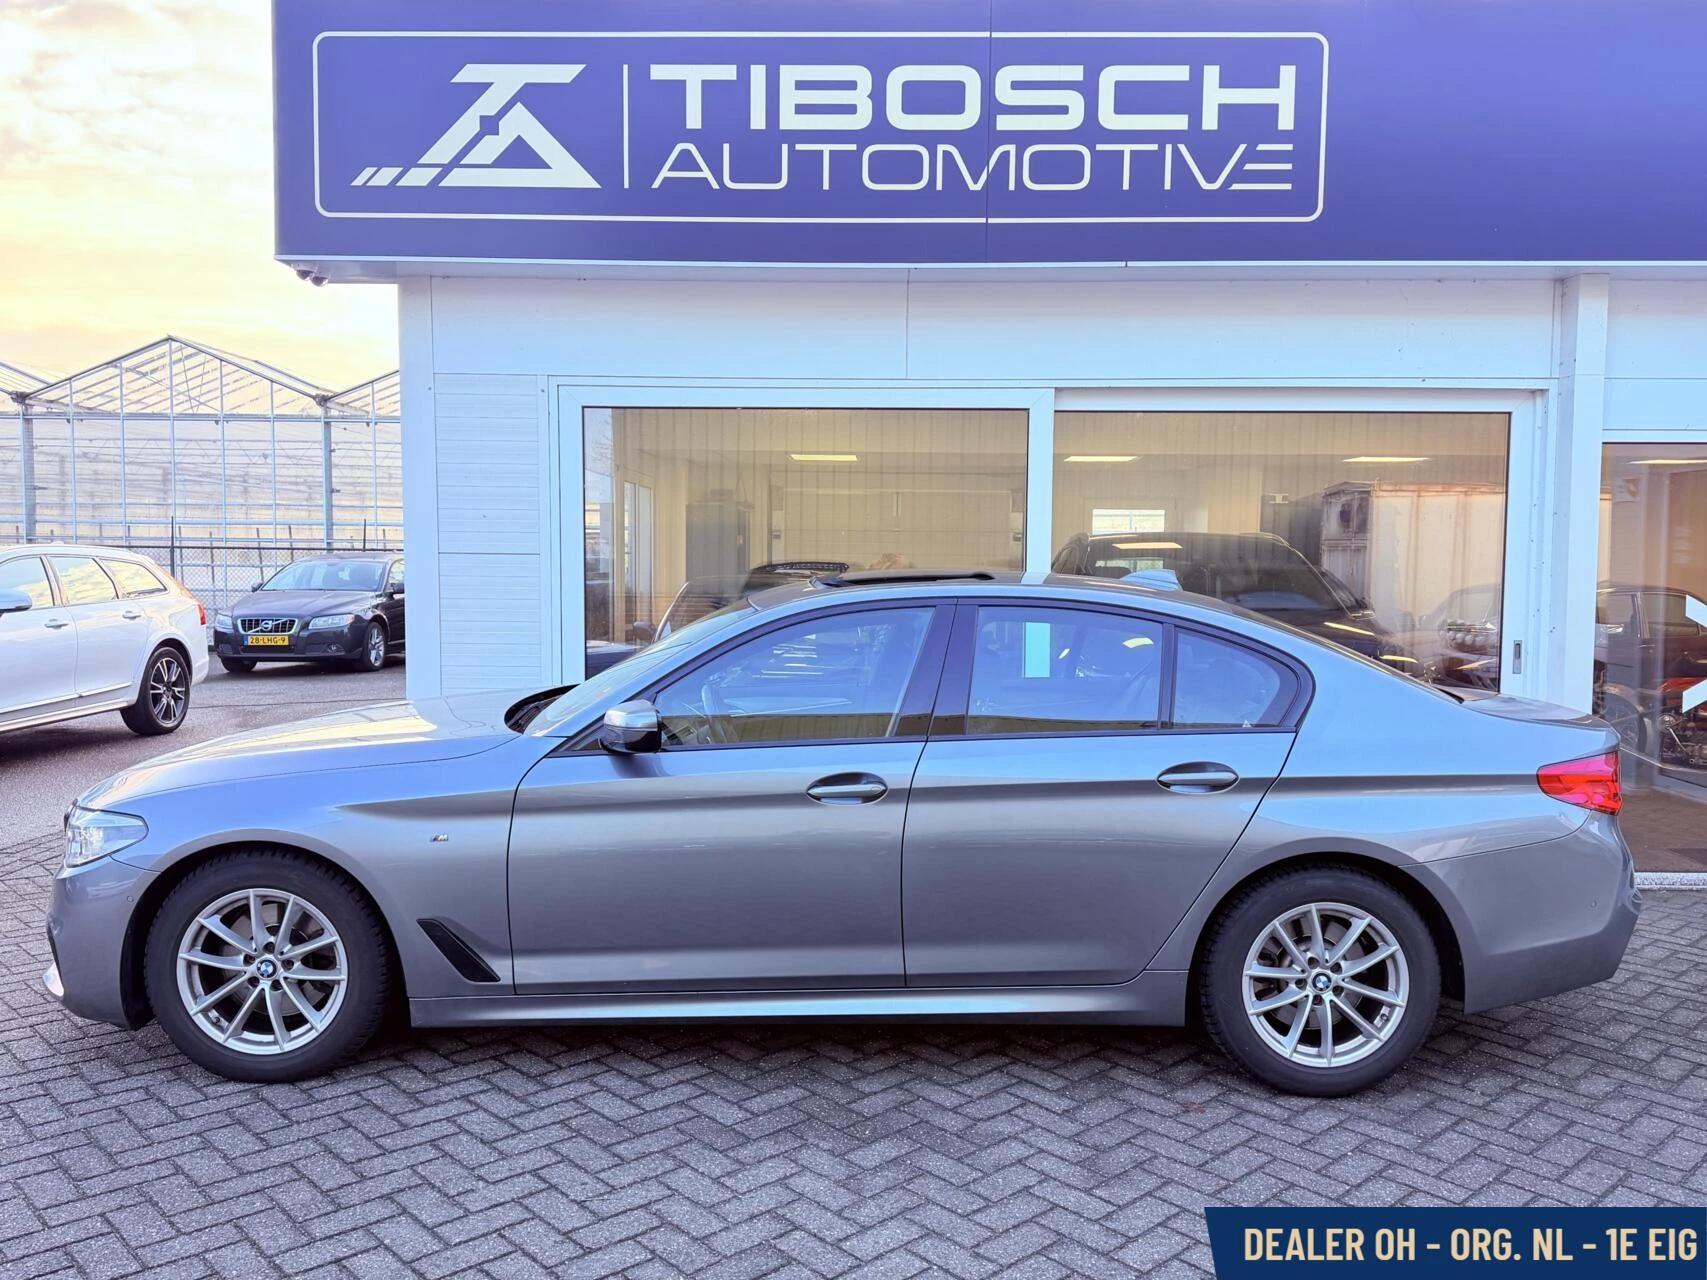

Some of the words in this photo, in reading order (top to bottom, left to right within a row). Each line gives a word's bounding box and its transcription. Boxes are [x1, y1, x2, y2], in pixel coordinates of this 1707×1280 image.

[650, 64, 1297, 131] TIBOSCH
[651, 142, 1293, 192] AUTOMOTIVE
[250, 636, 286, 645] 28-LHG-9
